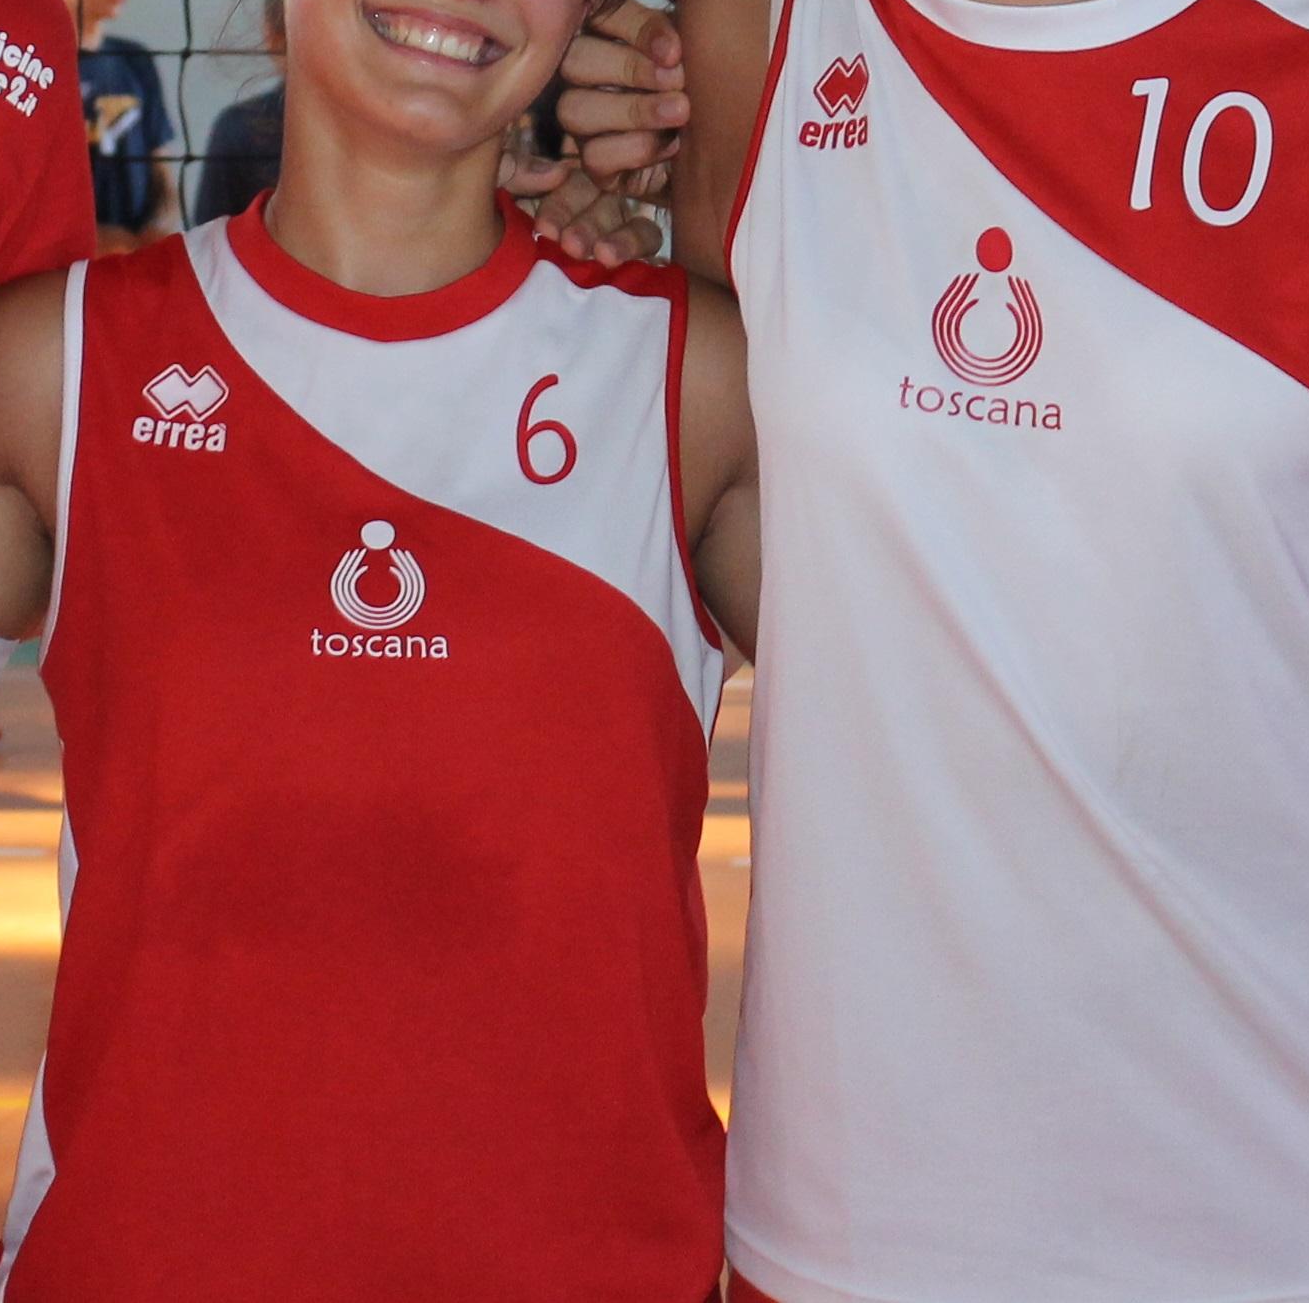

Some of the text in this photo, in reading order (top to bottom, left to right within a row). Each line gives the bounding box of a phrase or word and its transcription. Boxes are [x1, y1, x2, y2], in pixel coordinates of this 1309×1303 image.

[1128, 76, 1275, 228] 10
[515, 372, 578, 486] 6
[898, 376, 1064, 431] toscana
[309, 627, 451, 660] toscana
